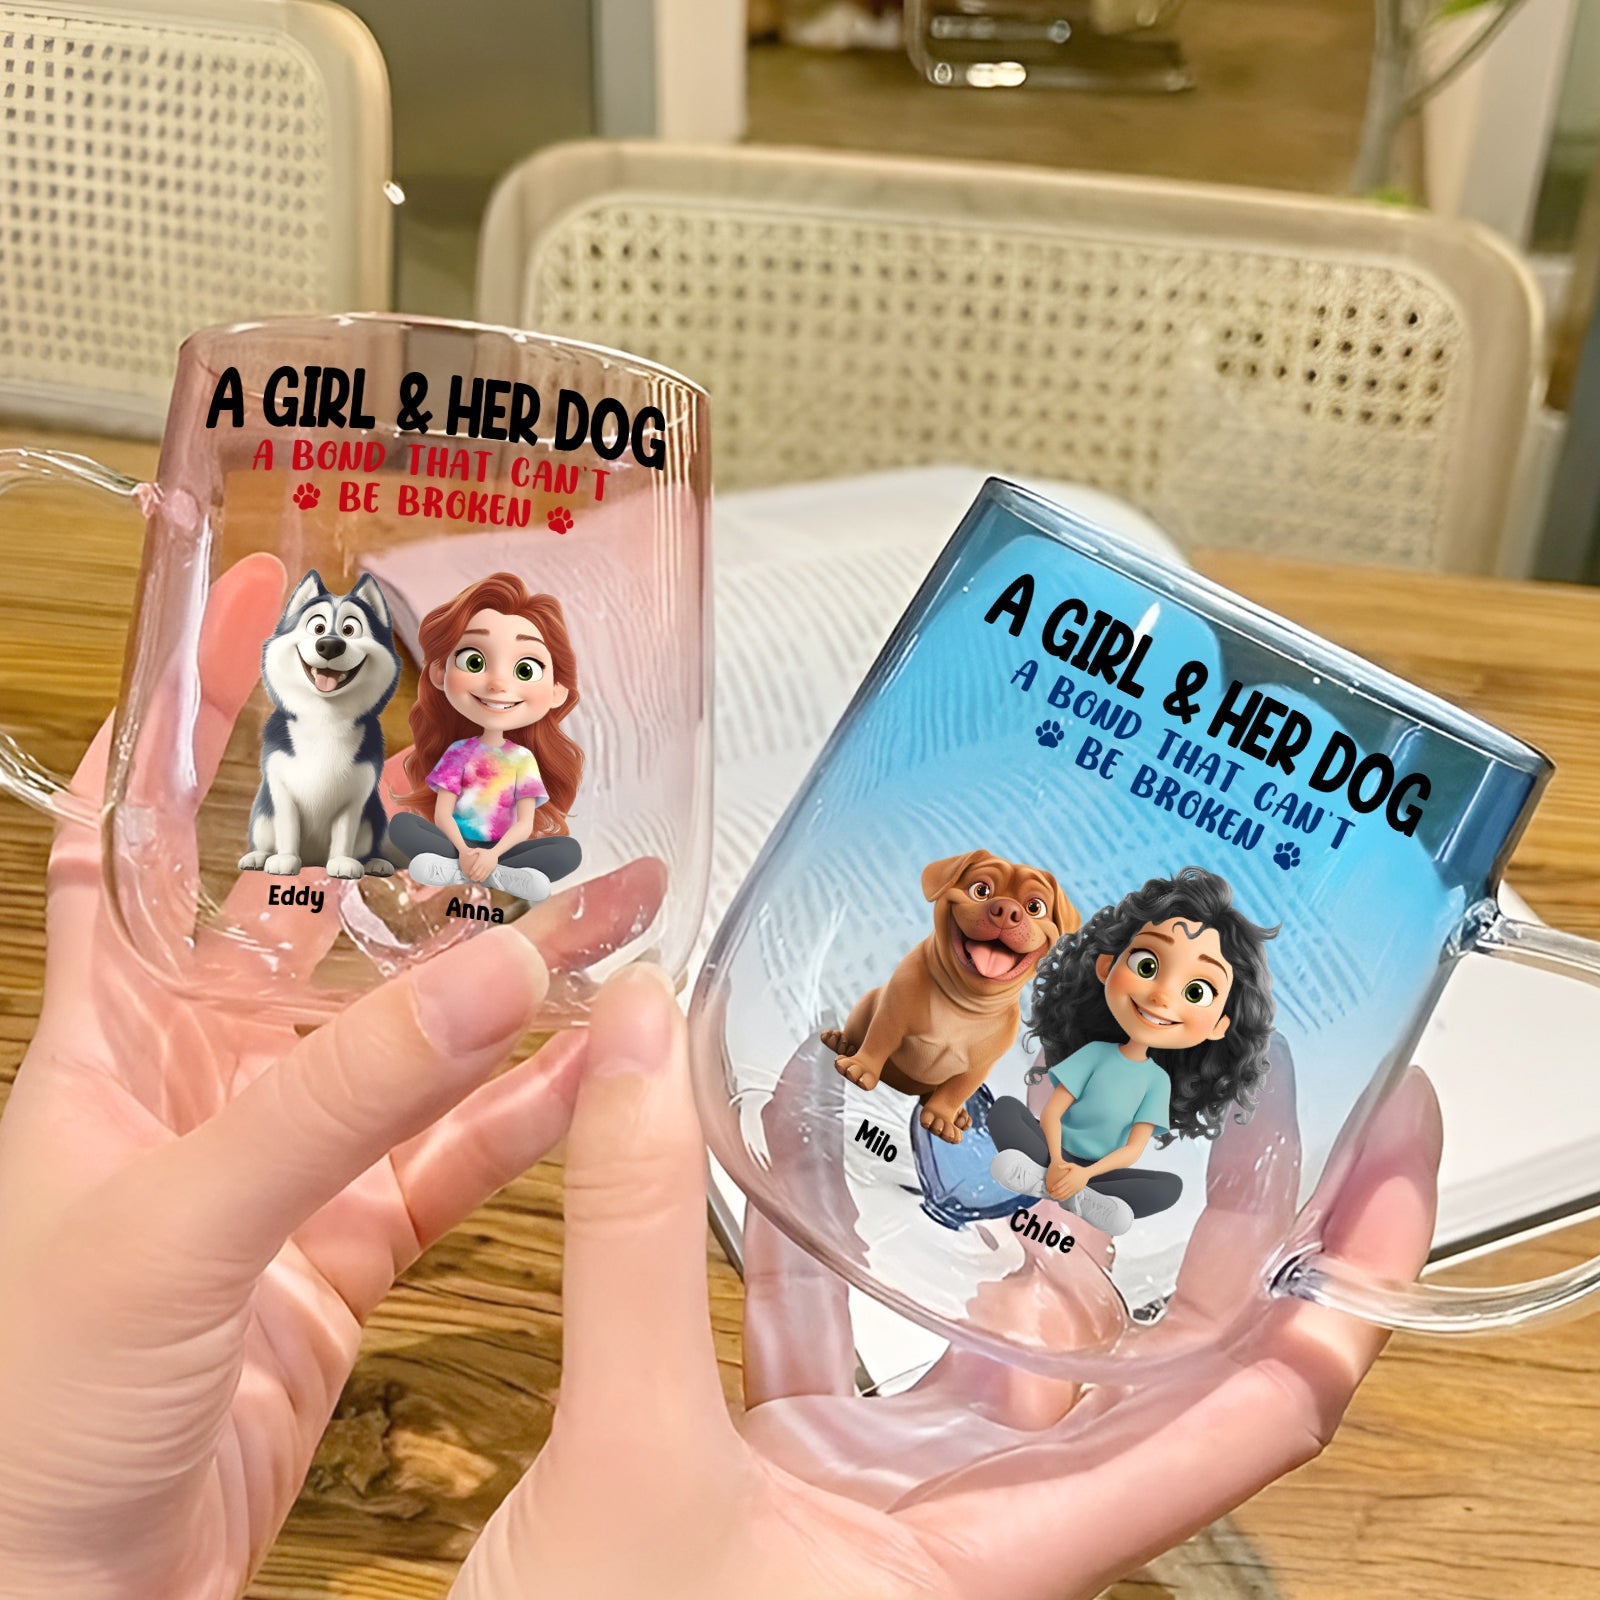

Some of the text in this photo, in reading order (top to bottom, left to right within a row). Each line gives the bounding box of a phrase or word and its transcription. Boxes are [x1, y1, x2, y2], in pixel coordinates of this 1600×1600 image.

[206, 365, 666, 471] A GIRL & HER DOG
[252, 439, 610, 502] A BOND THAT CAN'T
[338, 481, 532, 528] BE BROKEN
[984, 573, 1432, 838] A GIRL & HER DOG
[1011, 659, 1356, 850] A BOND THAT CAN'T
[1075, 736, 1265, 851] BE BROKEN
[268, 884, 325, 913] Eddy
[446, 896, 504, 925] Anna
[854, 1119, 898, 1163] Milo
[1009, 1208, 1076, 1254] Chloe
